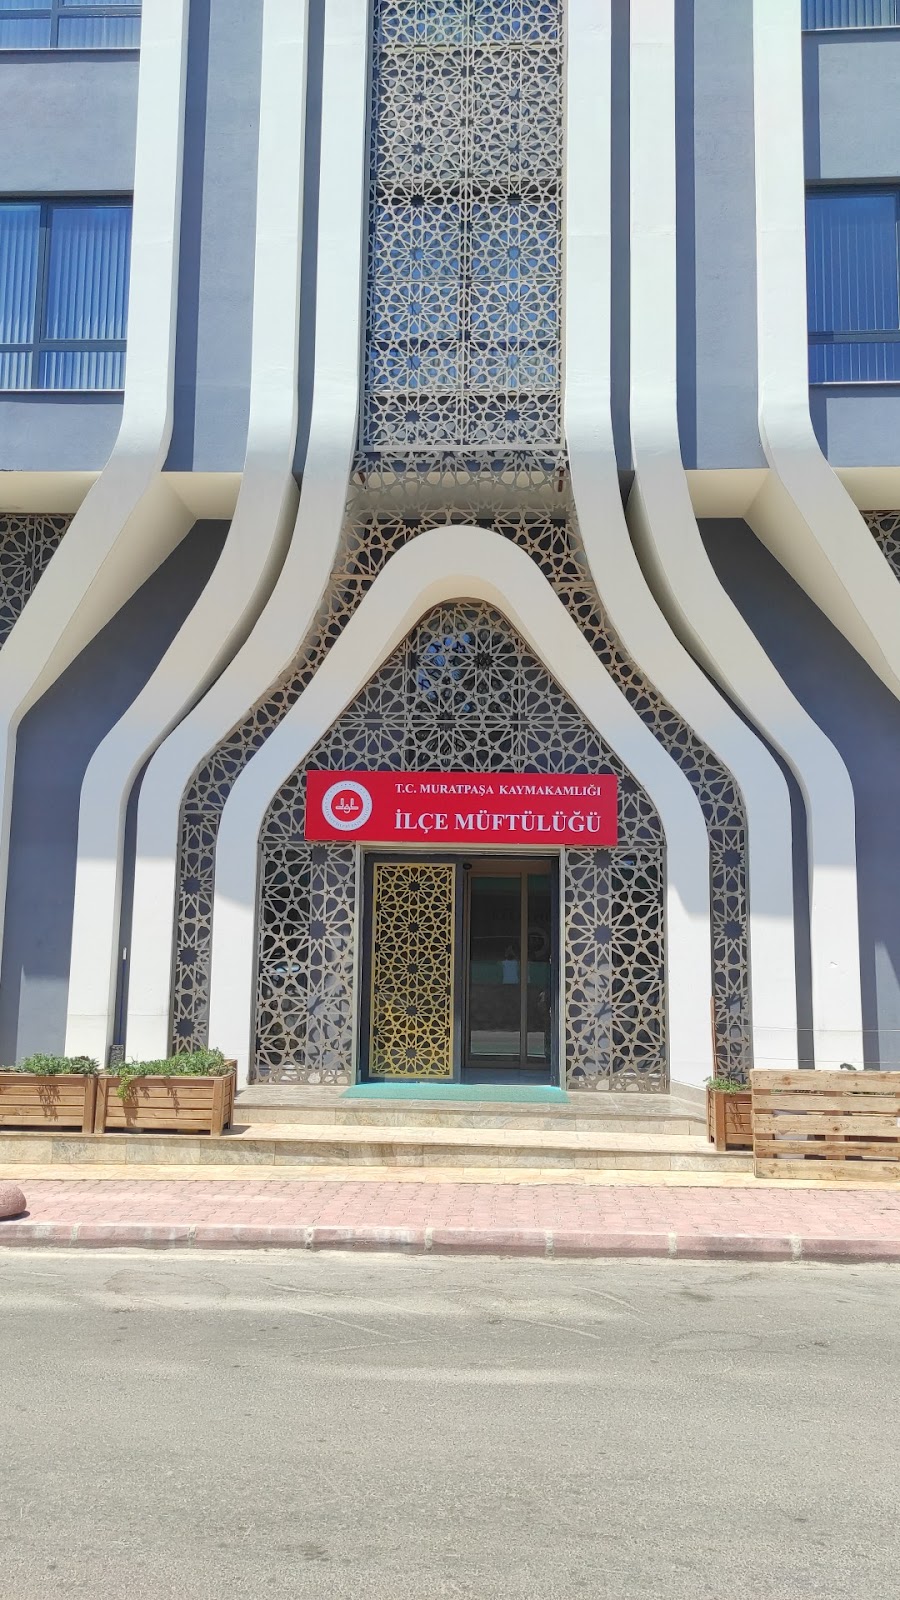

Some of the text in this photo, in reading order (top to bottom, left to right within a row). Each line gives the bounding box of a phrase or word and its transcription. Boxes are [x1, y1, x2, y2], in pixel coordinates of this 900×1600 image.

[395, 783, 601, 796] T.C. MURATPAŞA KAYMAKAMLIĞI
[394, 808, 449, 833] İLÇE
[454, 809, 601, 833] MÜFTÜLÜĞÜ
